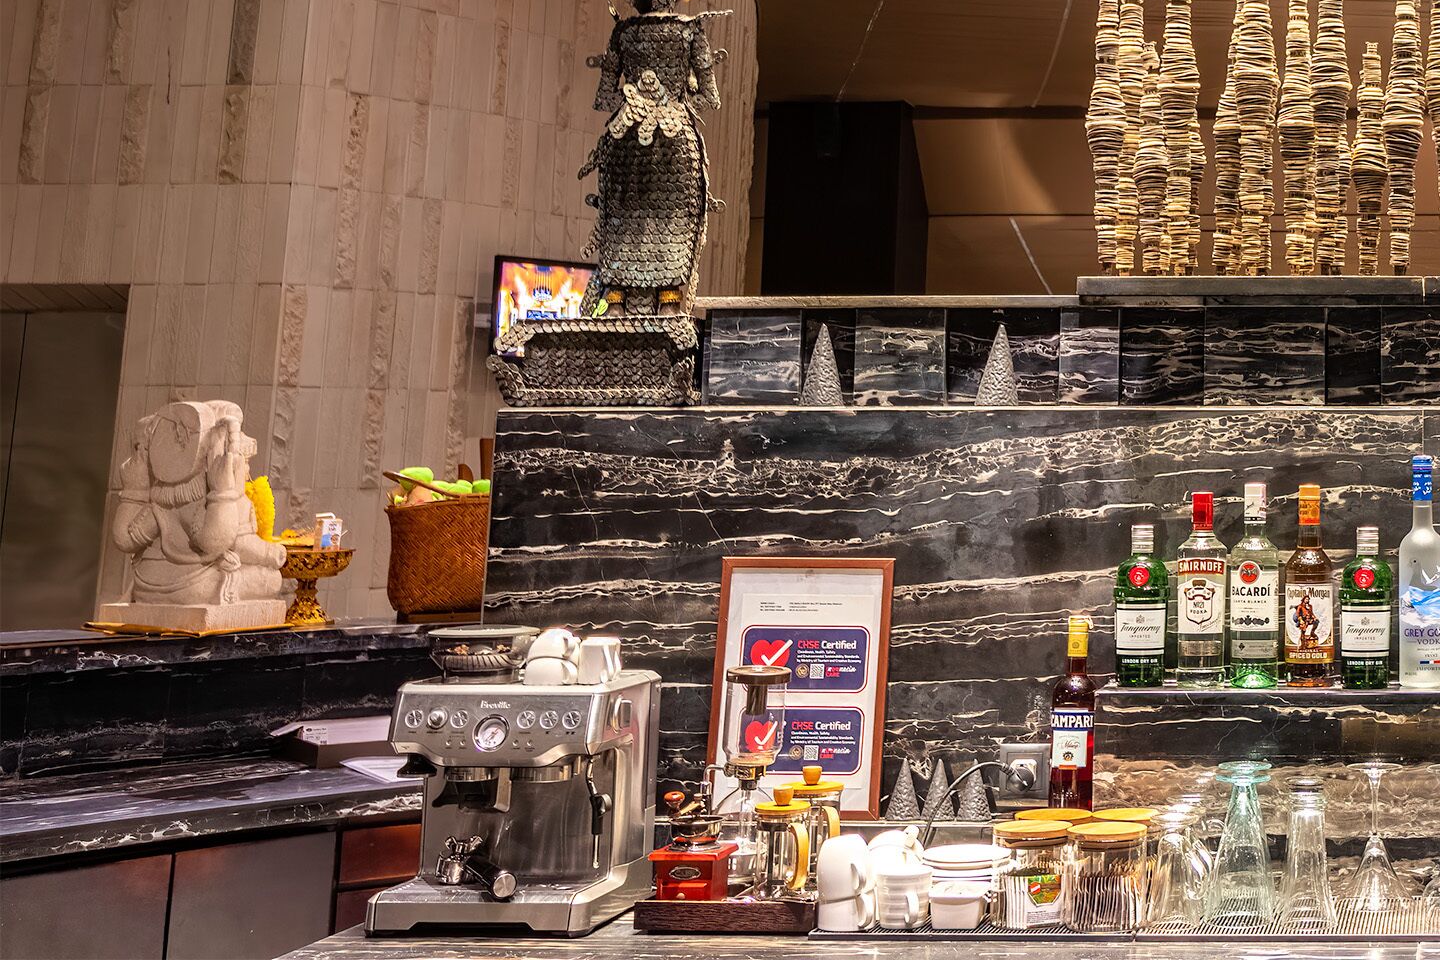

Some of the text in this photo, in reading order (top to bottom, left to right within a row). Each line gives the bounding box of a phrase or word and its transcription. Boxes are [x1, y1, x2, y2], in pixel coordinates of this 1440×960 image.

[1232, 584, 1271, 597] BACARDÍ
[1287, 587, 1330, 600] Captain Morgan
[1120, 622, 1161, 634] Tanqueray
[1345, 624, 1386, 636] Tanqueray
[1404, 628, 1424, 638] GREY
[797, 640, 857, 650] CHSE Certified
[480, 700, 511, 709] Breville
[791, 721, 851, 730] CHSE Certified
